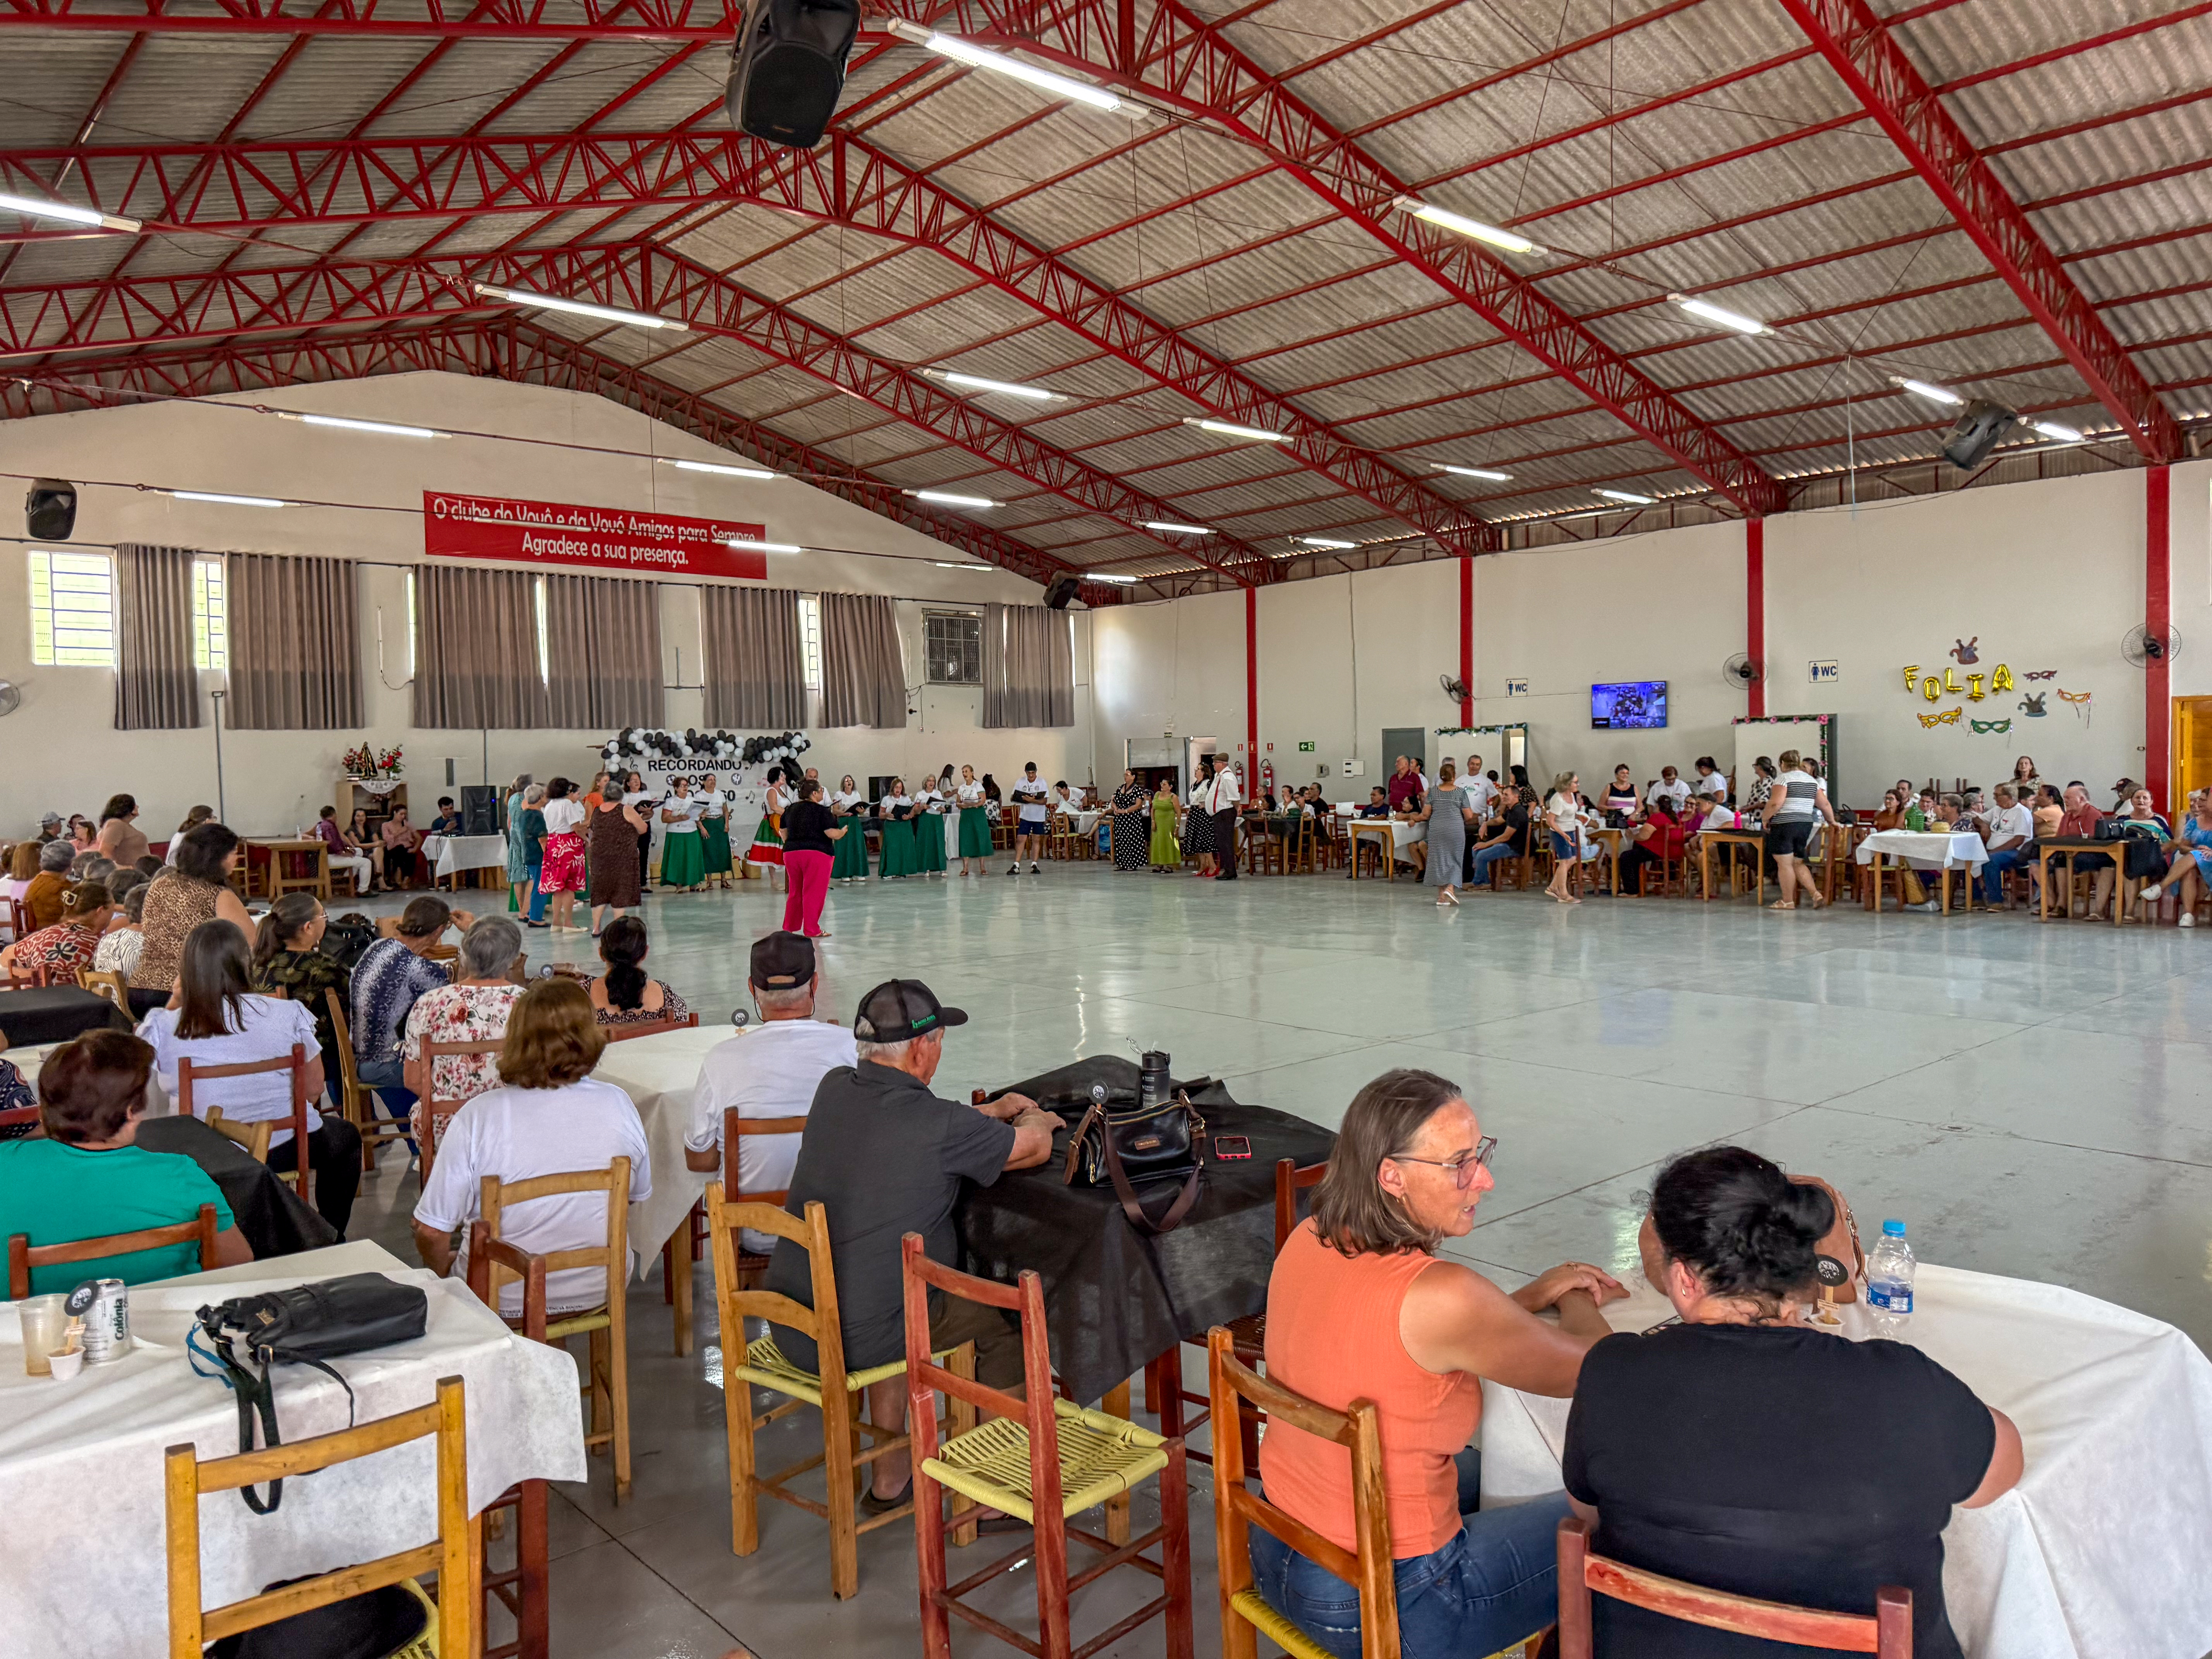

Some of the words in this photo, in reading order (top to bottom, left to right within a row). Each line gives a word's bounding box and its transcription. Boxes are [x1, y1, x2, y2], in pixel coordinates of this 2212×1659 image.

[434, 498, 447, 519] O
[451, 500, 490, 521] clube
[590, 512, 625, 535] Vovó
[628, 516, 674, 541] Amigos
[678, 526, 708, 543] para
[522, 531, 588, 556] Agradece
[591, 543, 601, 558] a
[605, 543, 627, 560] sua
[630, 546, 689, 568] presença.
[1821, 666, 1837, 676] WC
[1903, 664, 2013, 701] FOLIA
[1515, 683, 1527, 692] WC
[648, 759, 742, 771] RECORDANDO
